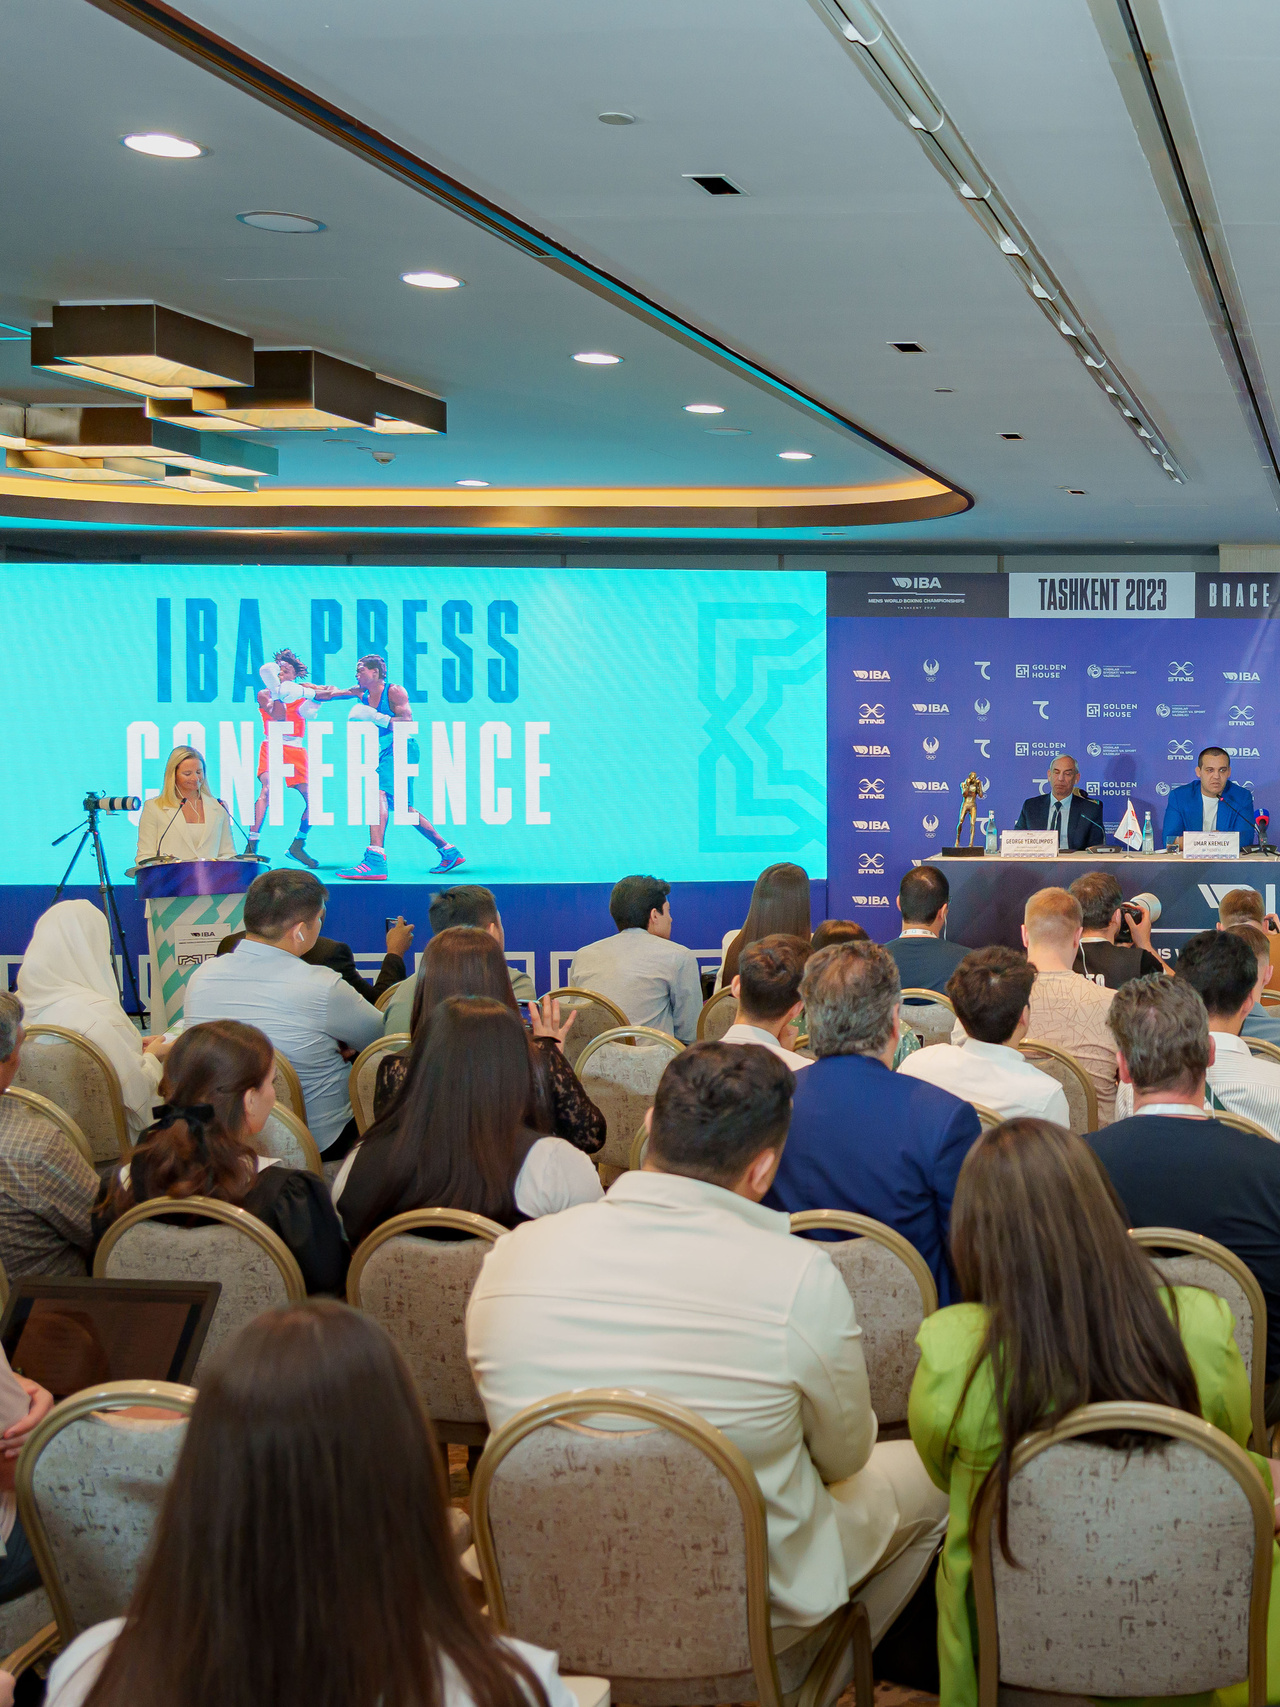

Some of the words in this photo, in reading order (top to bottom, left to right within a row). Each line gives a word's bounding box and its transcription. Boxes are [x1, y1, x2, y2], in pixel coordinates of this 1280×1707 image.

[914, 577, 942, 589] IBA
[1038, 578, 1119, 611] TASHKENT
[1126, 578, 1167, 611] 2023
[1209, 583, 1270, 608] BRACE
[156, 598, 265, 703] IBA
[310, 599, 519, 703] PRESS
[869, 670, 891, 679] IBA
[1239, 672, 1260, 681] IBA
[928, 704, 949, 713] IBA
[869, 745, 891, 755] IBA
[1239, 748, 1260, 757] IBA
[126, 720, 551, 826] CNFERENCE
[928, 782, 949, 790] IBA
[869, 821, 890, 830] IBA
[868, 896, 890, 905] IBA
